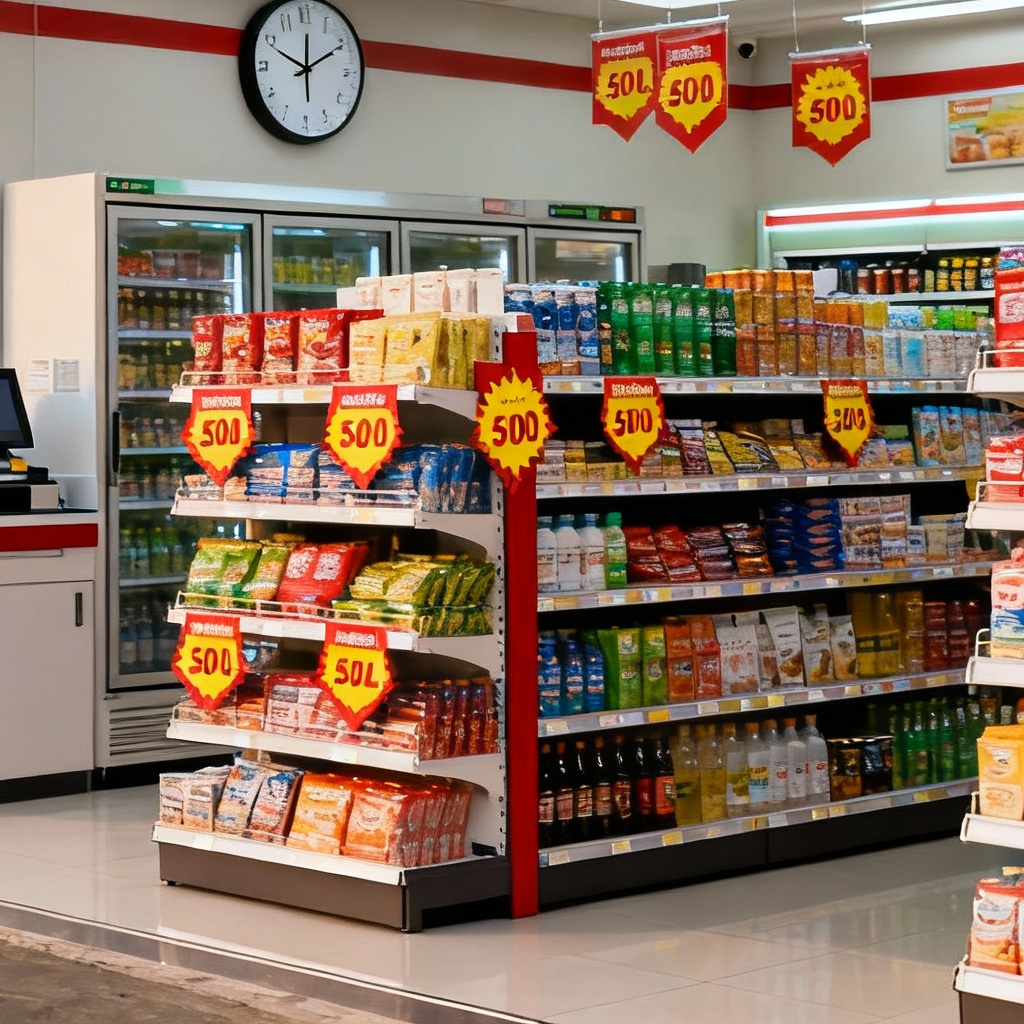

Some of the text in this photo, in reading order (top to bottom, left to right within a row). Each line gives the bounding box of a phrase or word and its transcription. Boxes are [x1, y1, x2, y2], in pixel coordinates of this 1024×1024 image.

[669, 74, 714, 107] 500
[809, 94, 856, 124] 500
[200, 418, 241, 447] 500
[340, 418, 387, 448] 500
[493, 411, 538, 447] 500
